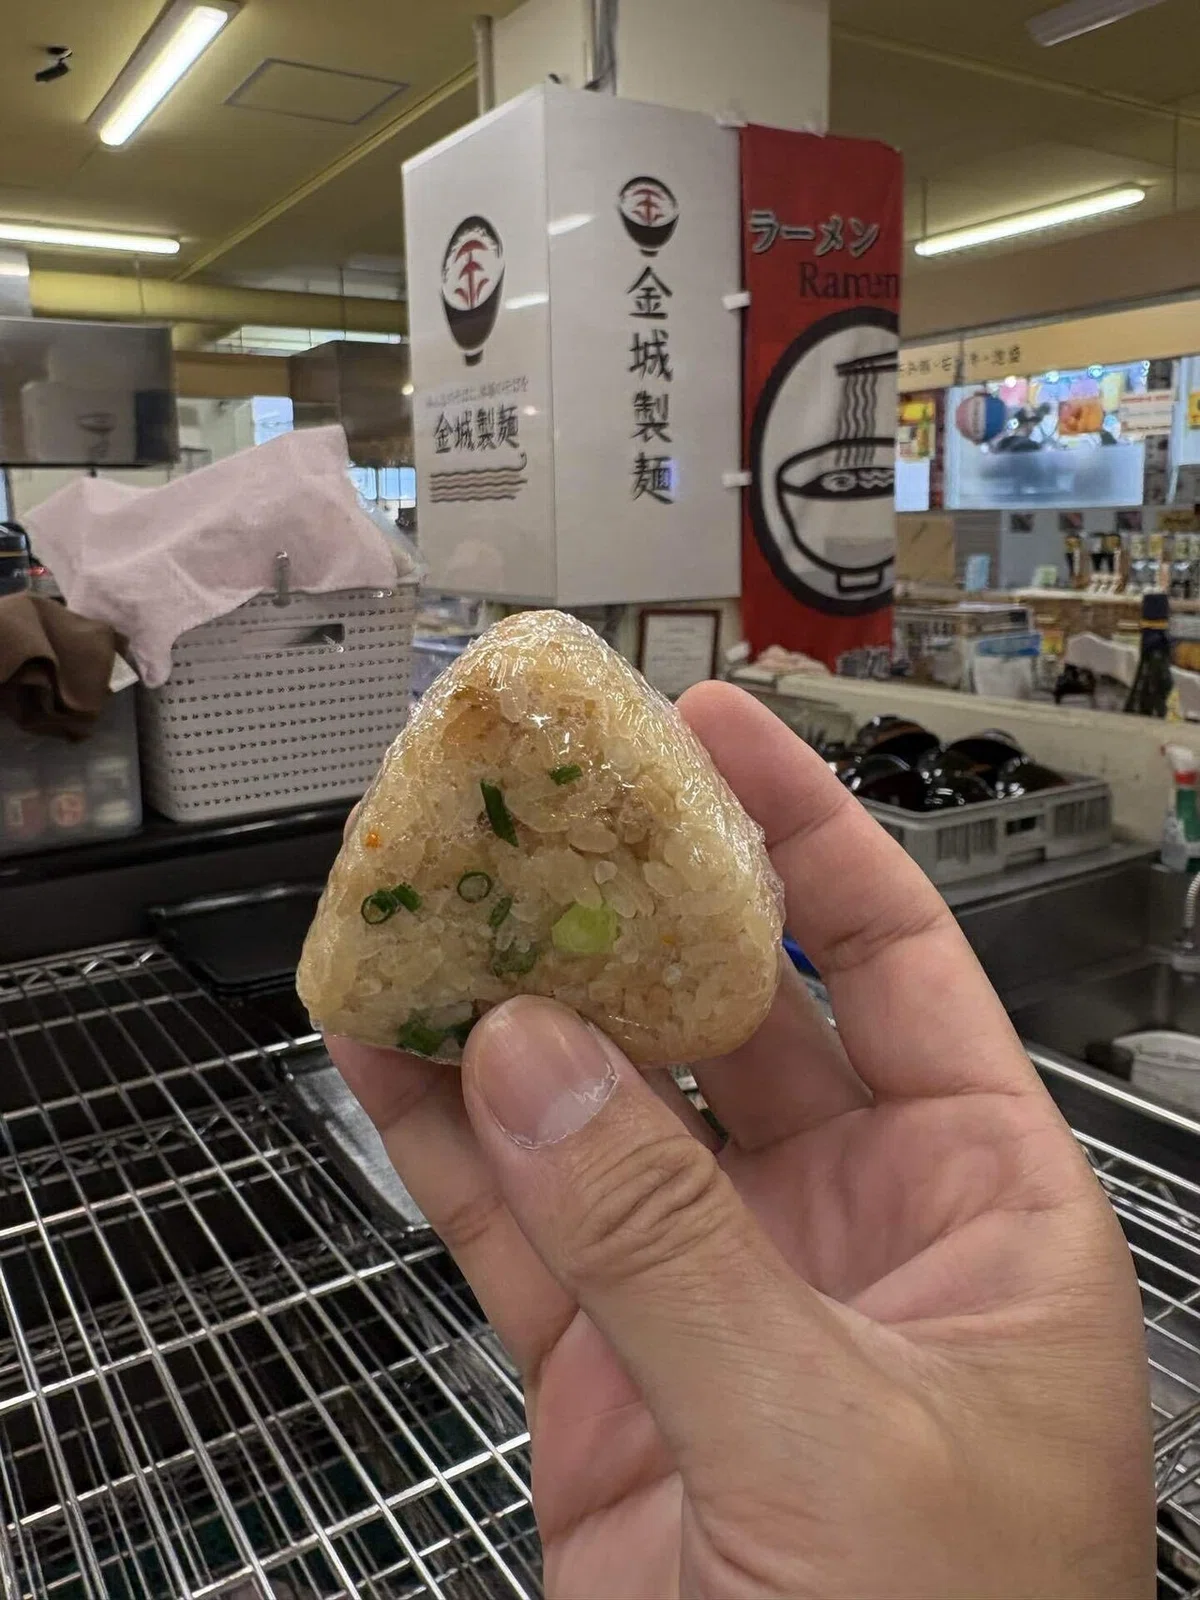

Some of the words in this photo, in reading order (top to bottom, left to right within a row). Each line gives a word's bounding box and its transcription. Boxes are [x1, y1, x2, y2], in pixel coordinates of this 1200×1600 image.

[750, 210, 880, 258] ラーメン
[799, 262, 899, 299] Ramen
[627, 266, 673, 504] 金城製麺
[434, 404, 520, 454] 金城製麺
